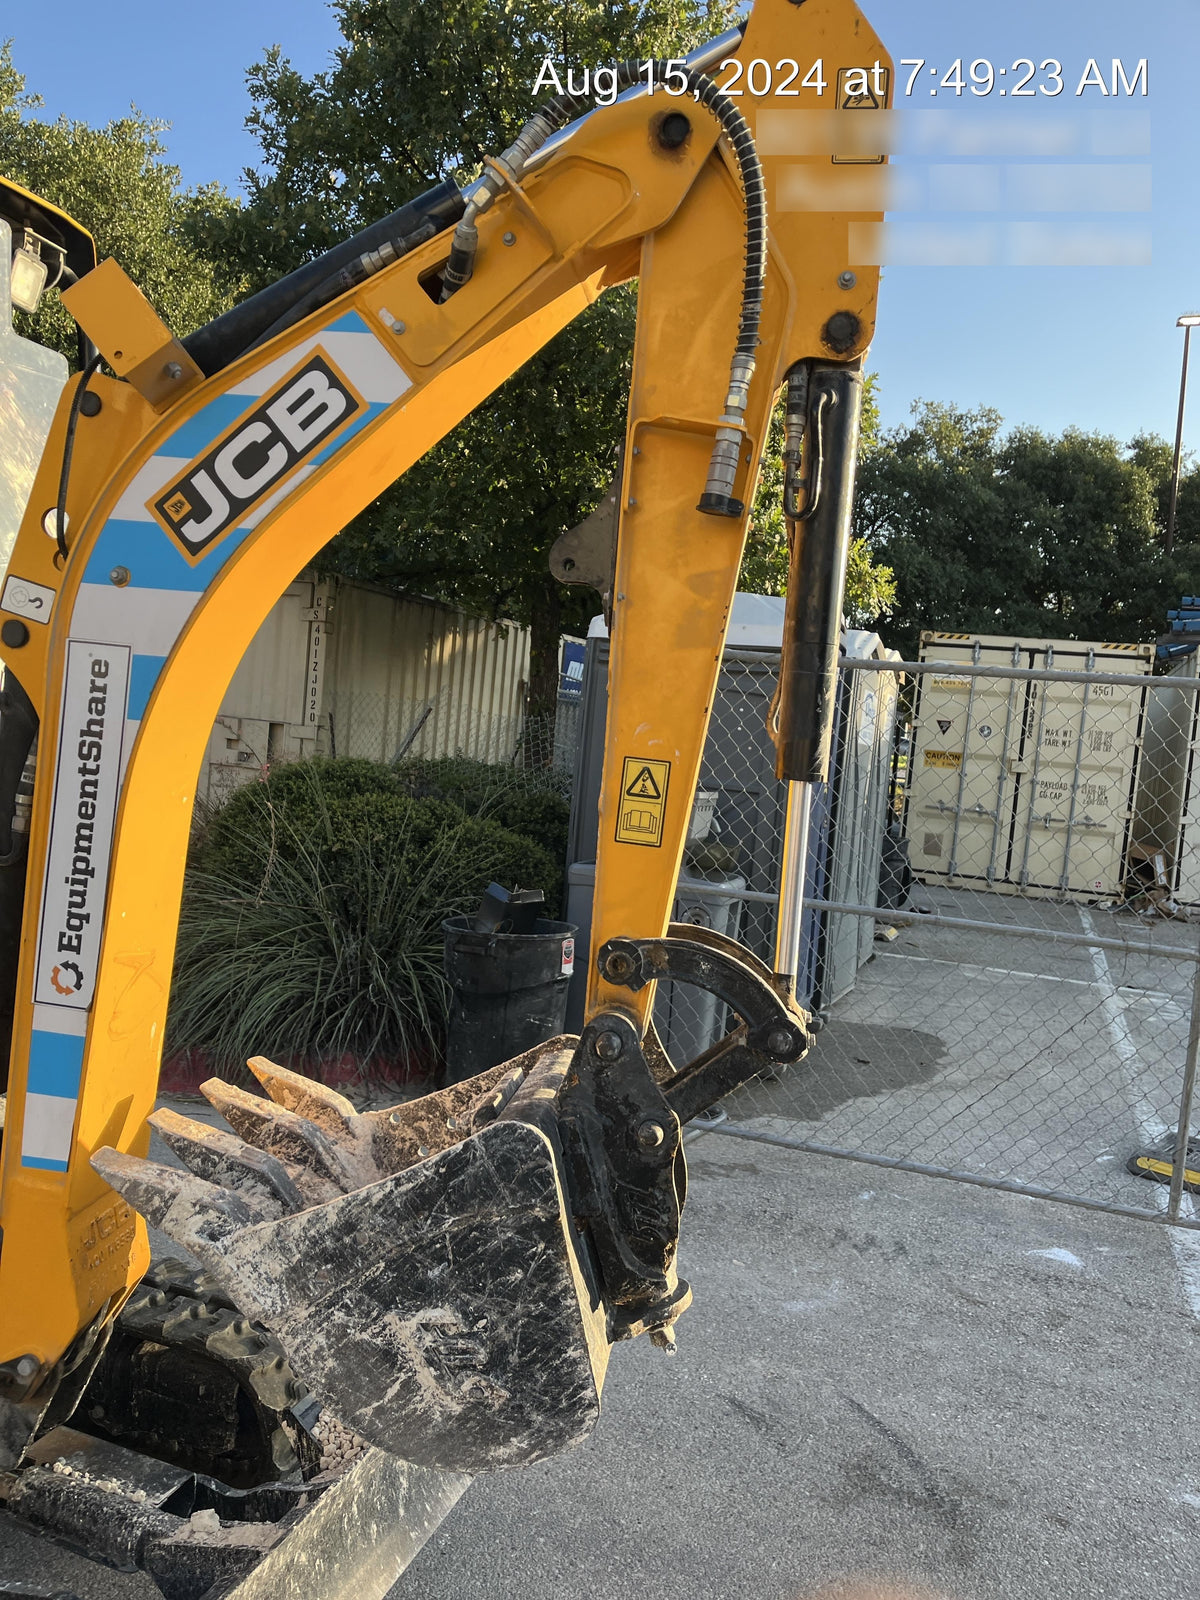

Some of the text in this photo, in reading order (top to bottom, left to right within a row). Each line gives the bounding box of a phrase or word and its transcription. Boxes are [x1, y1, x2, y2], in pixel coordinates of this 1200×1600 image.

[179, 369, 348, 544] JCB
[1092, 685, 1114, 697] 45G1
[1044, 728, 1059, 737] MAX
[925, 752, 961, 762] CAUTION
[1040, 780, 1068, 791] PAYLOAD
[57, 658, 110, 955] EquipmentShare
